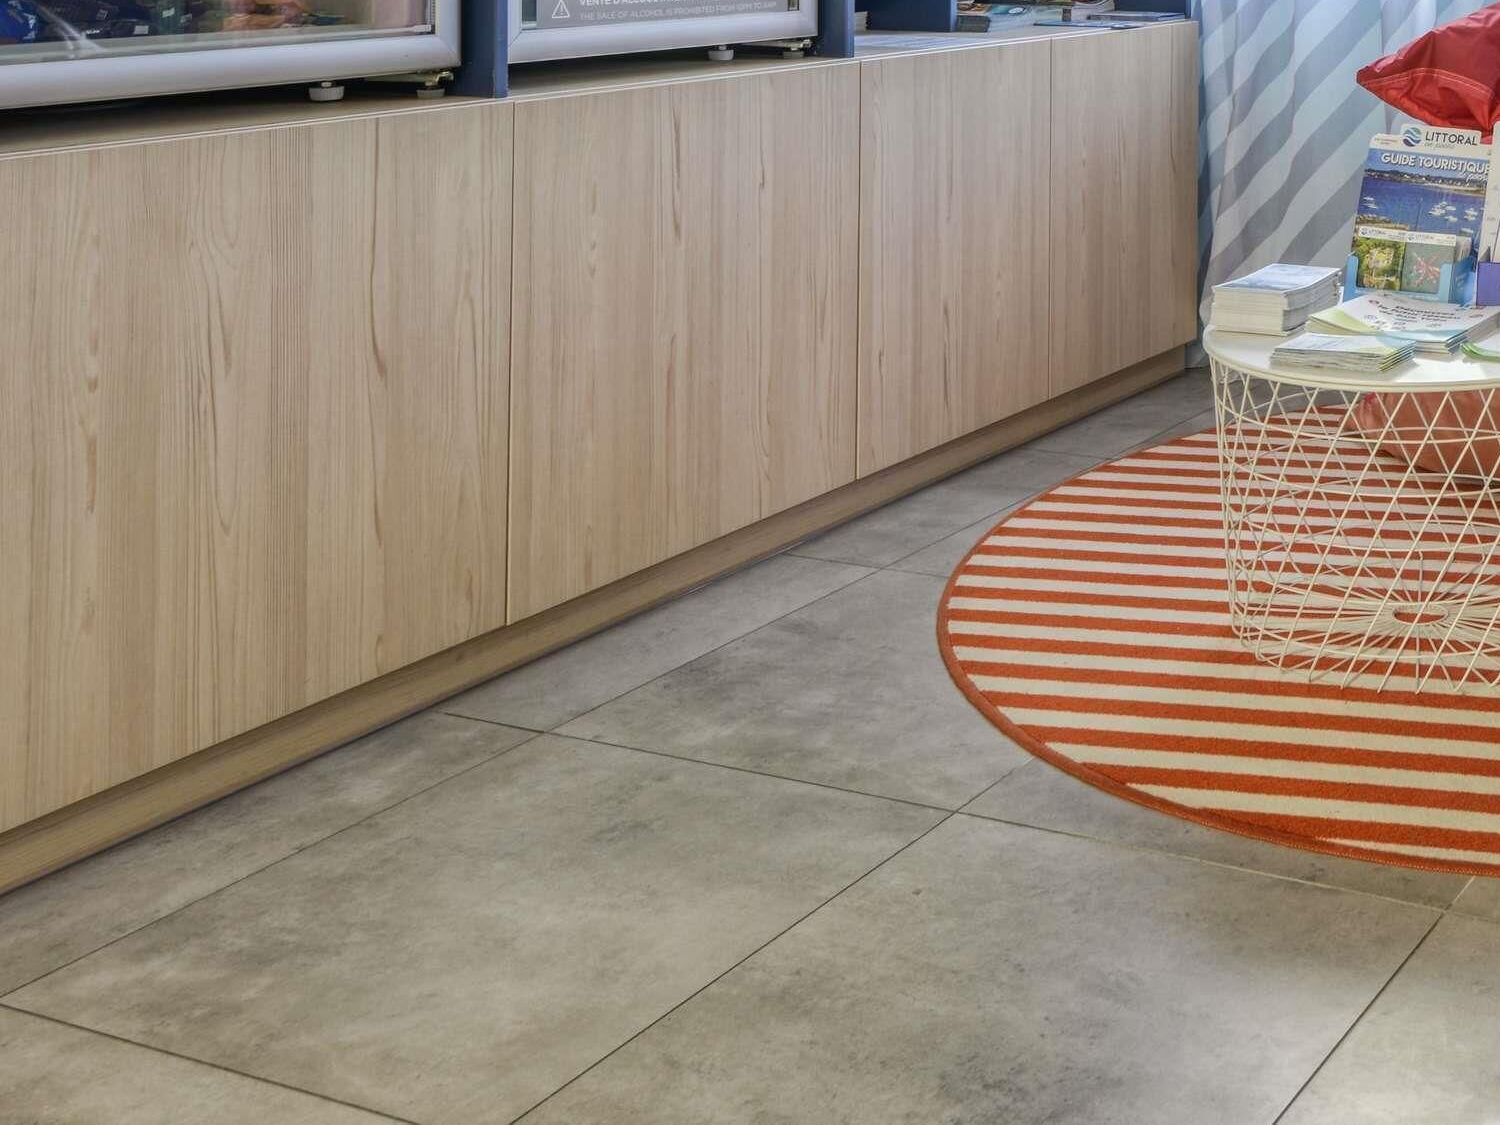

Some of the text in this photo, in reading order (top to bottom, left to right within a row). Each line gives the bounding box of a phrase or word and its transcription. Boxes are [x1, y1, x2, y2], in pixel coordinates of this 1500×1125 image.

[630, 7, 664, 18] ALCOHOL
[1425, 131, 1478, 146] LITTORAL
[1381, 153, 1417, 166] GUIDE
